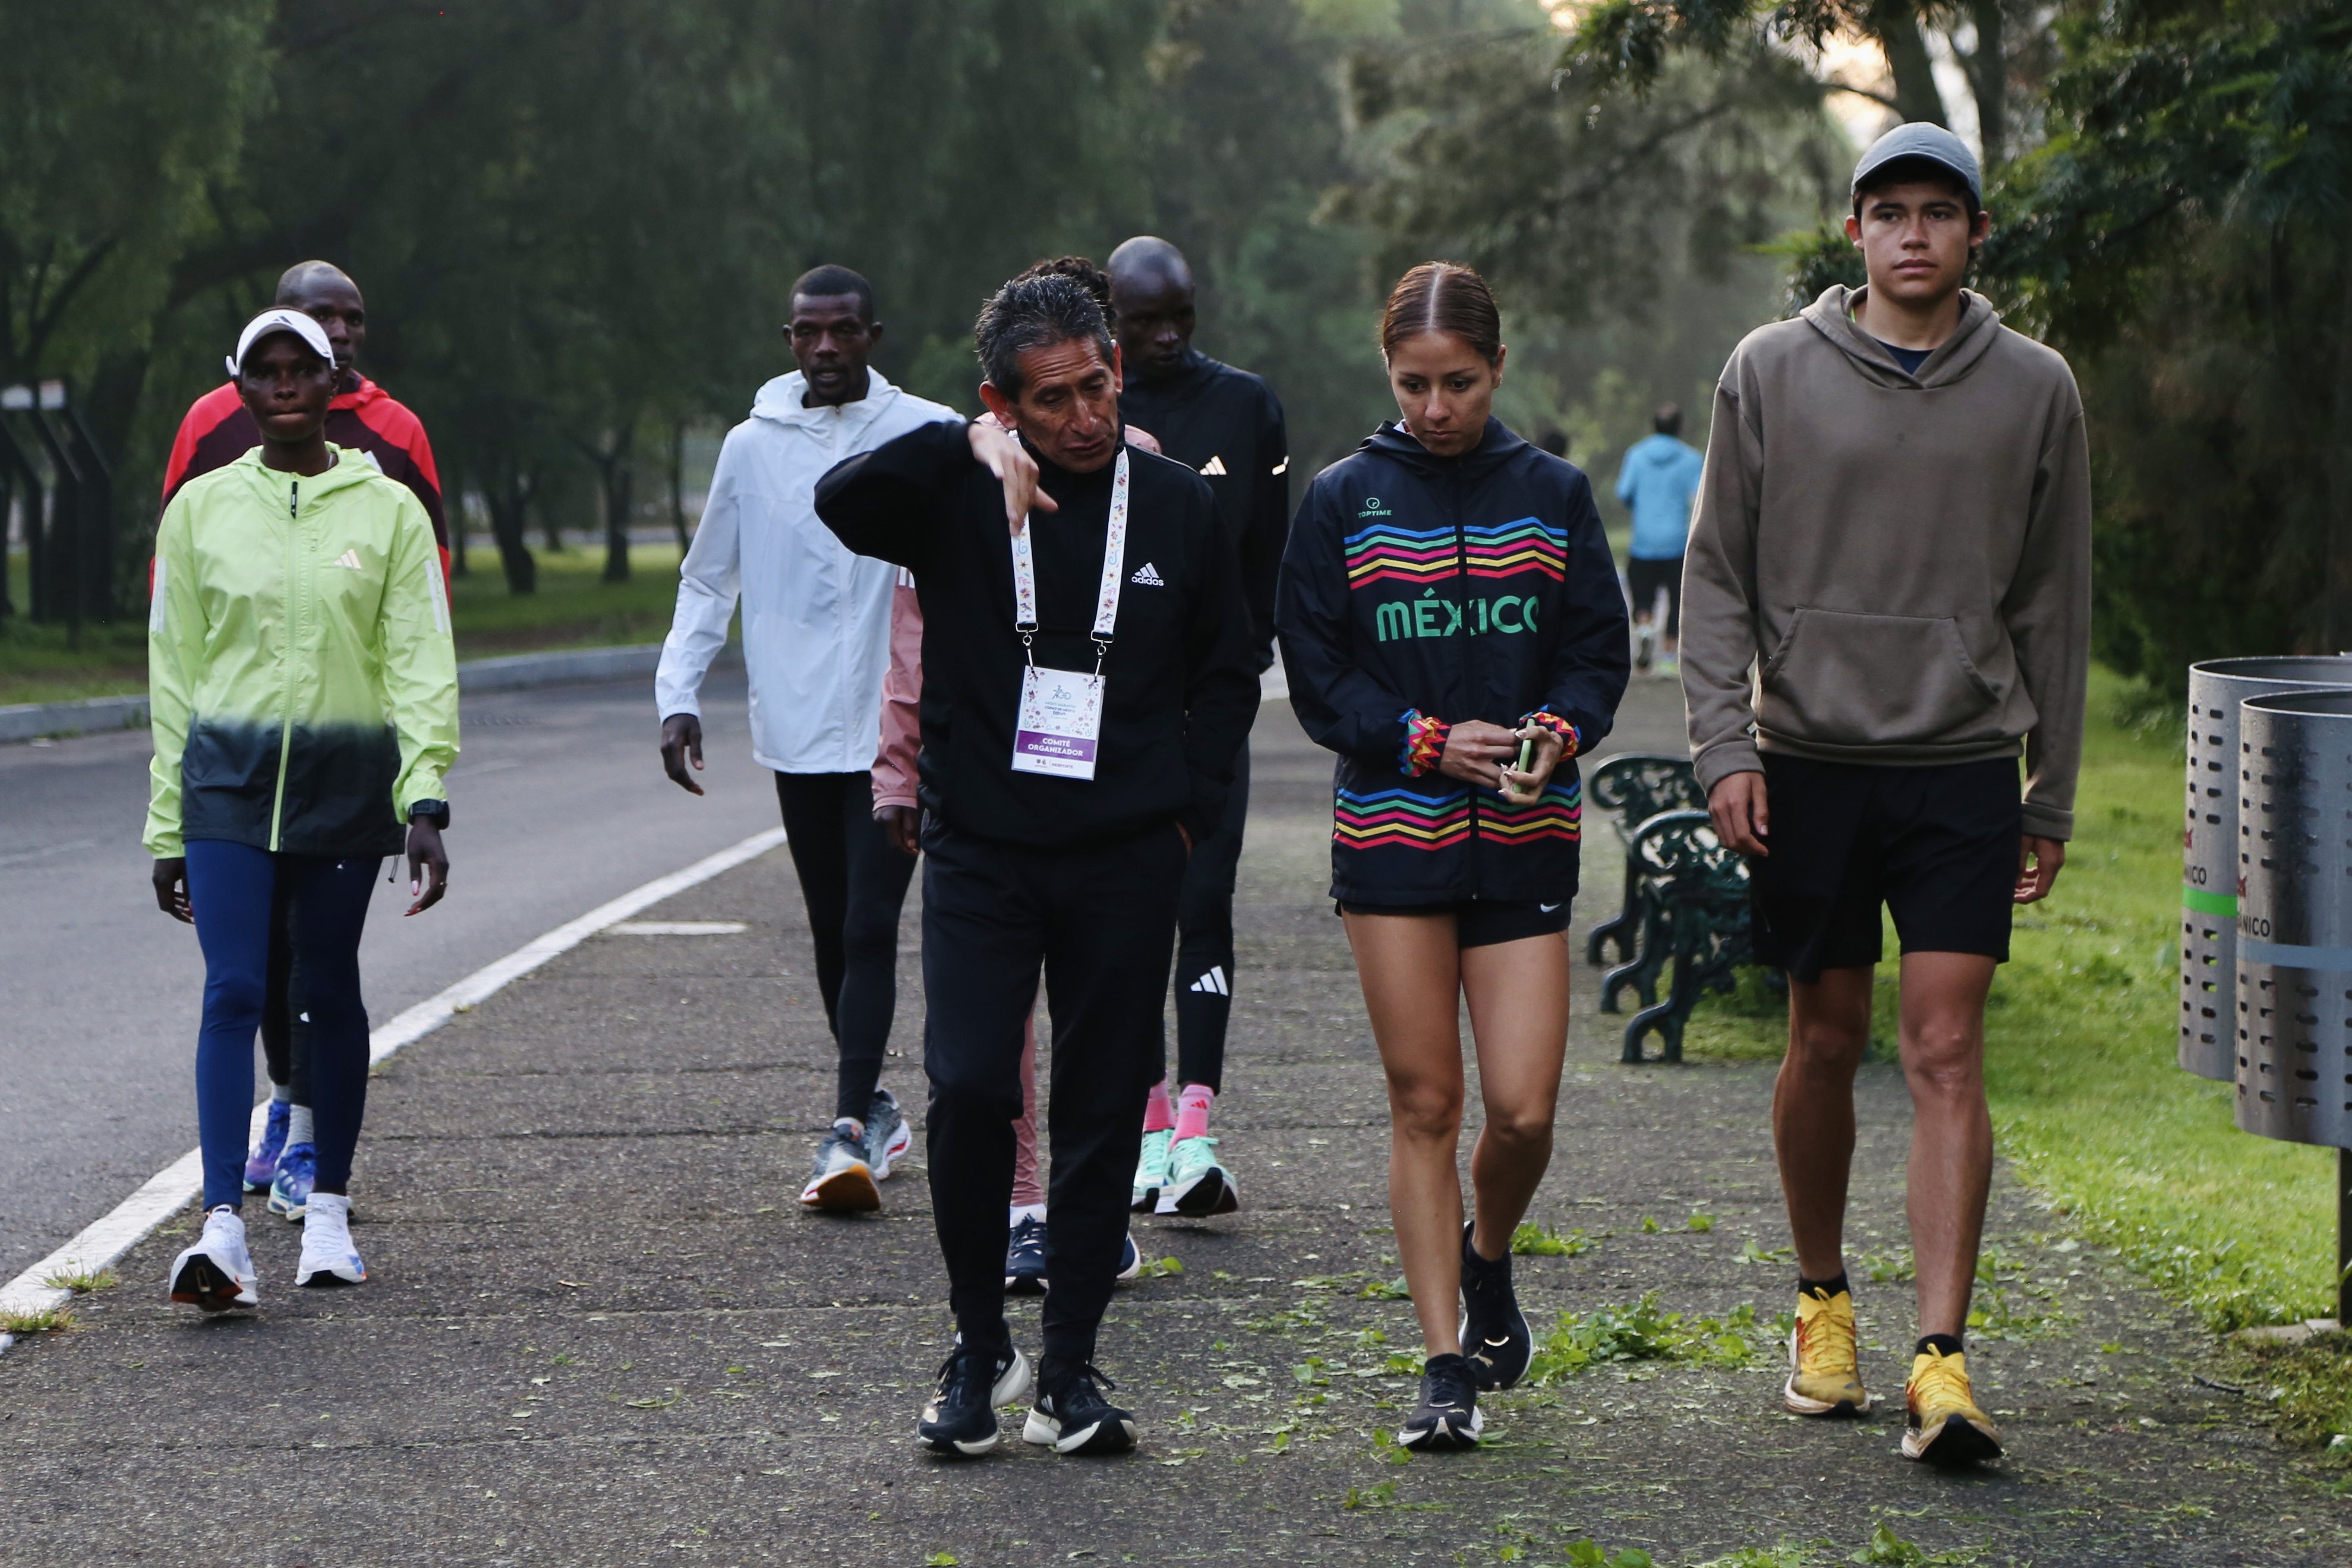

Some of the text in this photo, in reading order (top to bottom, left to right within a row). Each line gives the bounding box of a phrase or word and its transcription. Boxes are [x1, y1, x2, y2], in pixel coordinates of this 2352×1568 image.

[1358, 510, 1392, 518] TOPTIME
[1131, 576, 1164, 586] adidas
[1042, 738, 1070, 747] COMITÉ
[1027, 743, 1083, 756] ORGANIZADOR
